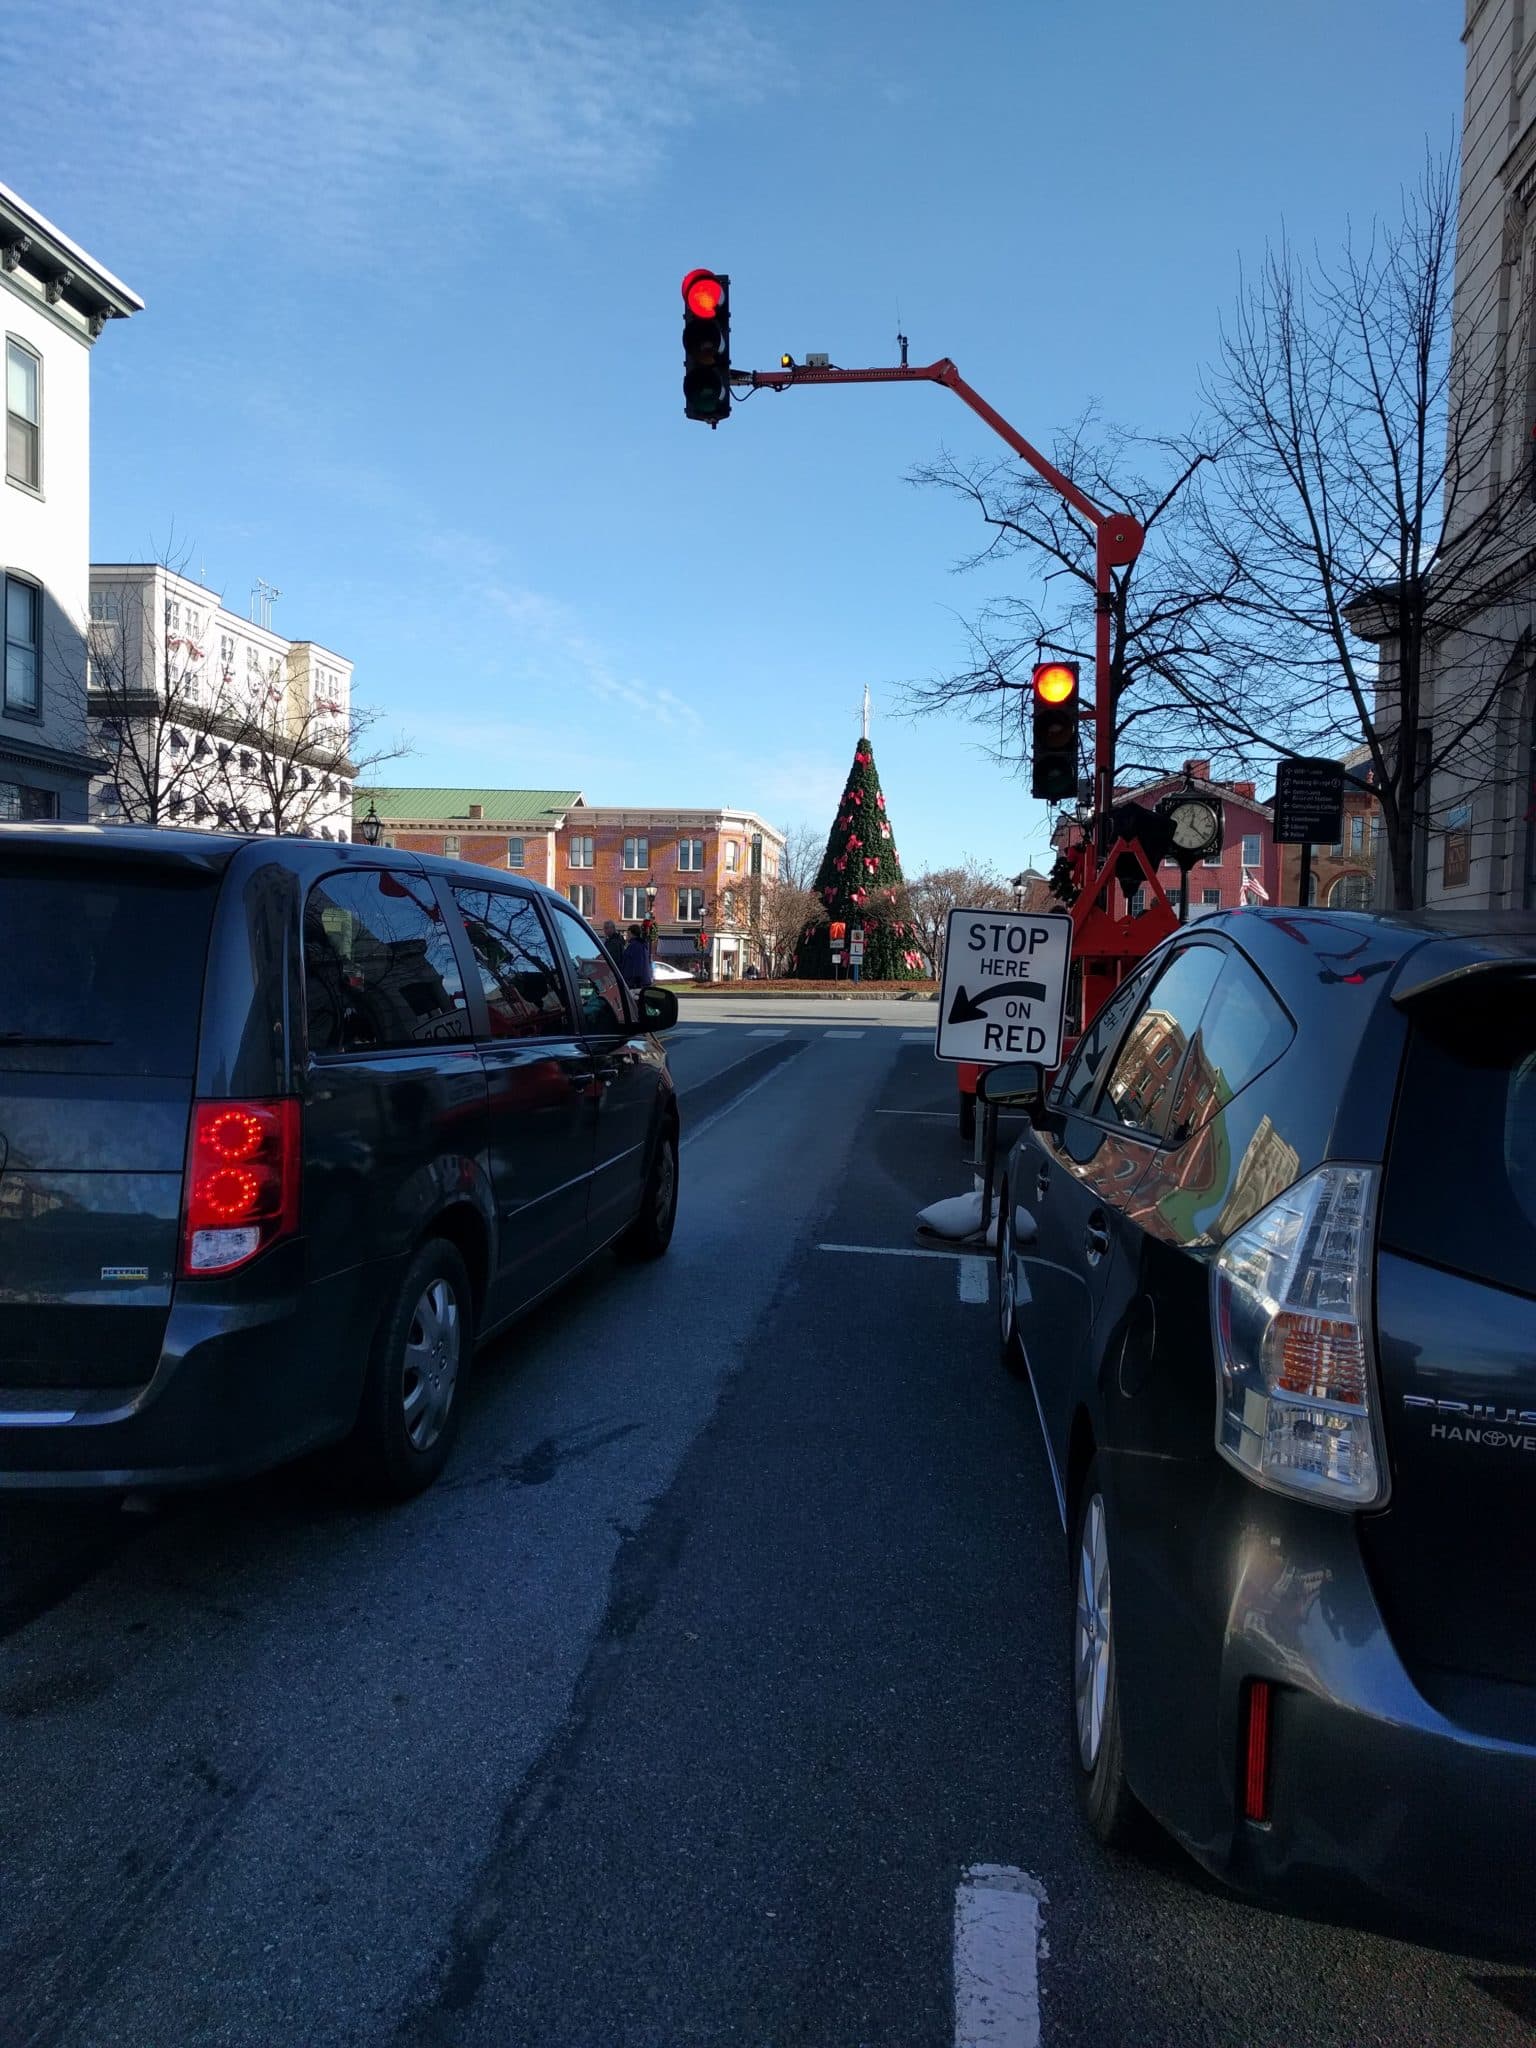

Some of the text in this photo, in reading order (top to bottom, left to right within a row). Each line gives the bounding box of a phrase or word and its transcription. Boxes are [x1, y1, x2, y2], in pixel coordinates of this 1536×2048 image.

[968, 923, 1049, 955] STOP
[980, 958, 1030, 978] HERE
[1005, 1001, 1032, 1019] ON
[984, 1023, 1046, 1054] RED
